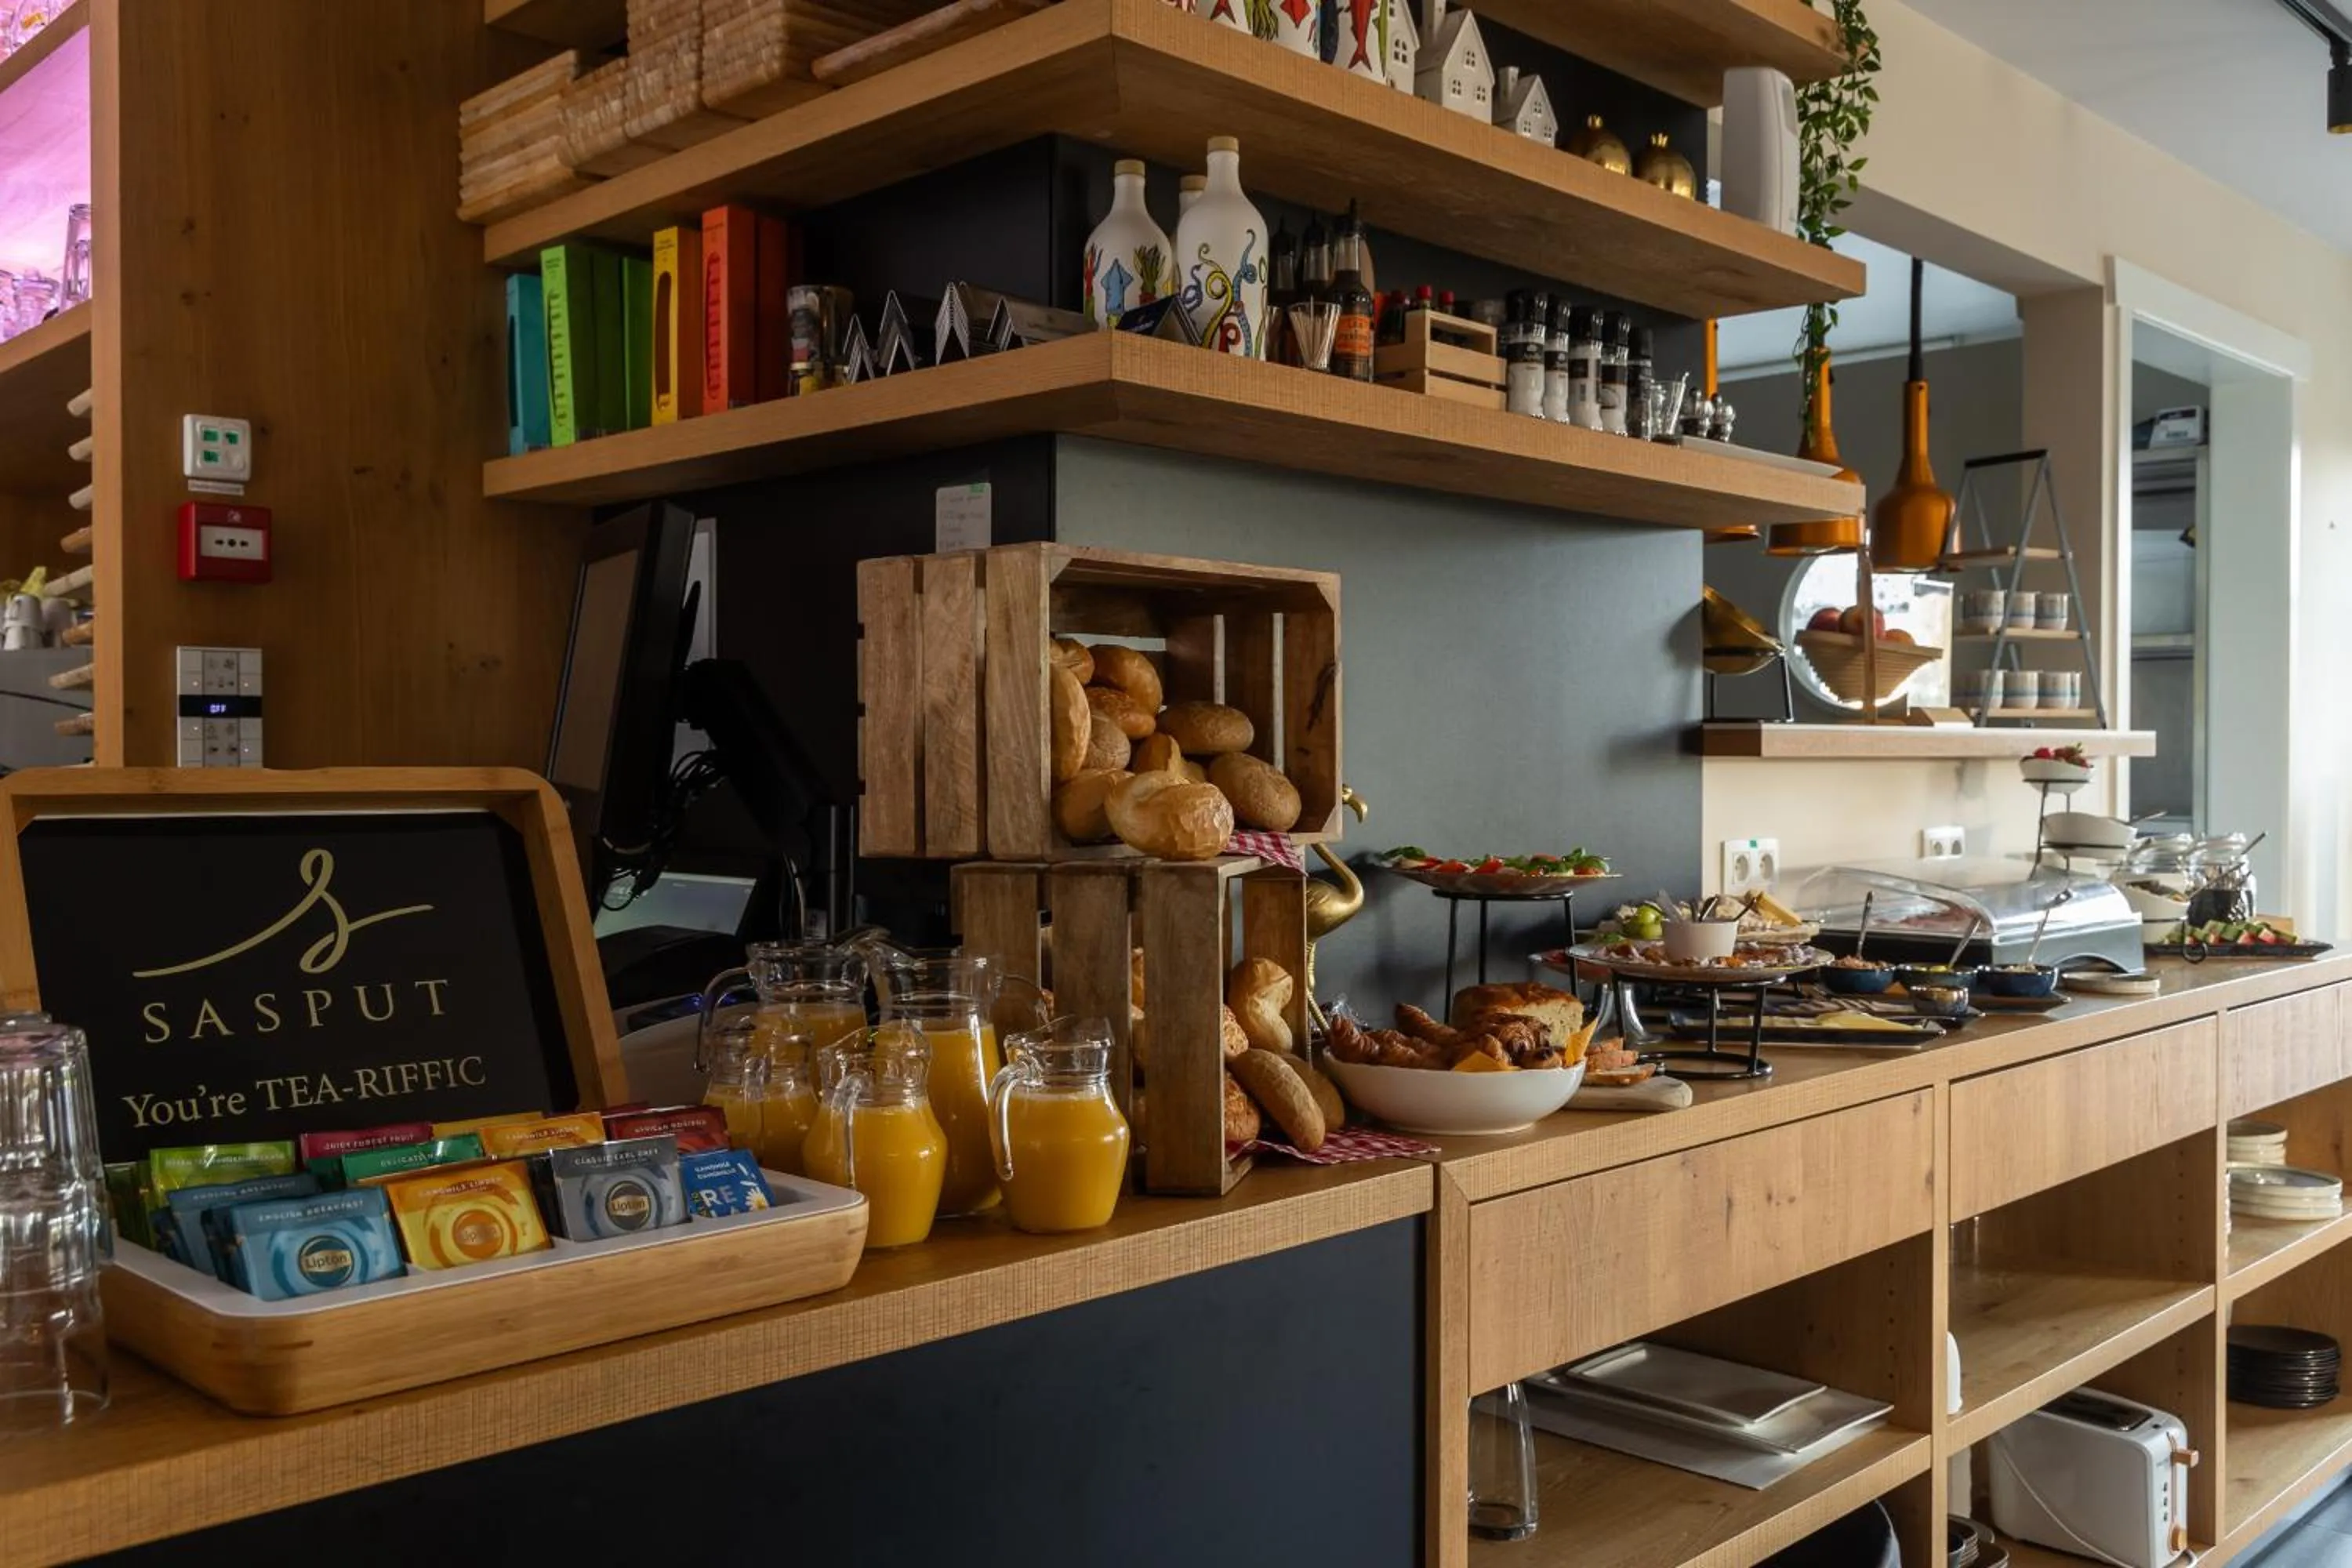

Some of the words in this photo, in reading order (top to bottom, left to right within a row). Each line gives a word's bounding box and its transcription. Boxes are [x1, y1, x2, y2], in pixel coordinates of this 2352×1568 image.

[143, 979, 449, 1044] SASPUT
[256, 1055, 487, 1112] TEA-RIFFIC
[258, 1210, 303, 1222] ENGLISH
[307, 1200, 364, 1216] BREAKFAST
[612, 1198, 645, 1213] Lipton
[304, 1250, 350, 1271] Lipton
